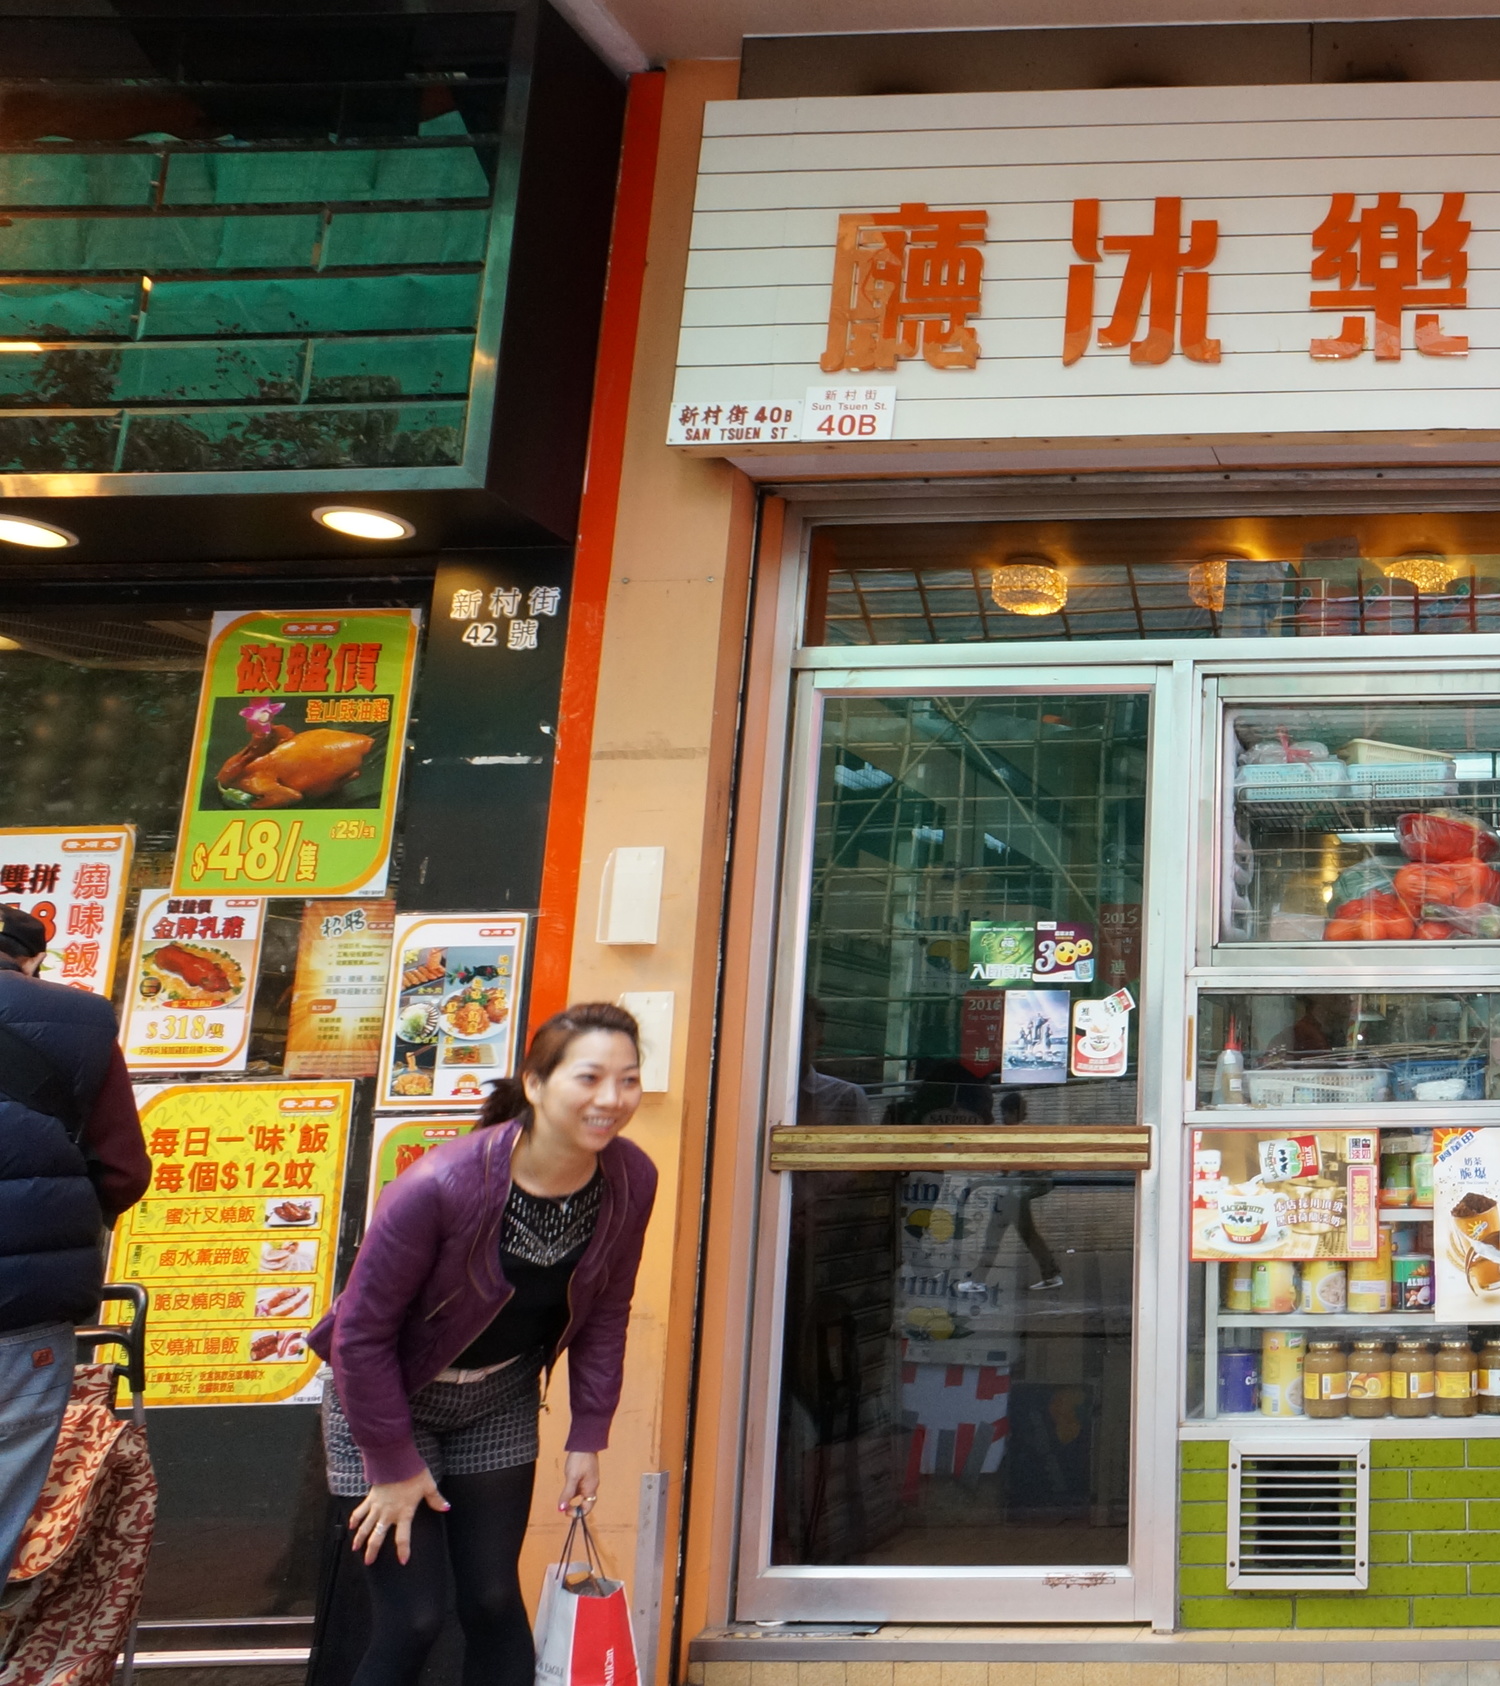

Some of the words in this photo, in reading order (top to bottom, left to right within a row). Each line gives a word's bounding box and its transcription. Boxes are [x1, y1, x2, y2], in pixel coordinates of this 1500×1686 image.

[825, 389, 878, 401] 新村街
[811, 402, 832, 411] Sun
[838, 402, 868, 411] Tsuen
[685, 428, 710, 440] SAN
[720, 427, 760, 440] TSUEN
[771, 427, 788, 439] ST
[816, 414, 877, 436] 40B
[450, 586, 561, 620] 新村街
[236, 642, 383, 693] 破盤價
[305, 698, 390, 723] 登山豉油雞
[0, 863, 61, 895] 雙拼
[322, 908, 367, 938] 招聘
[154, 1159, 315, 1193] 每個$12蚊
[165, 1206, 255, 1226] 蜜汁叉燒飯
[154, 1292, 246, 1312] 脆皮燒肉飯
[147, 1336, 241, 1357] 叉燒紅腸飯
